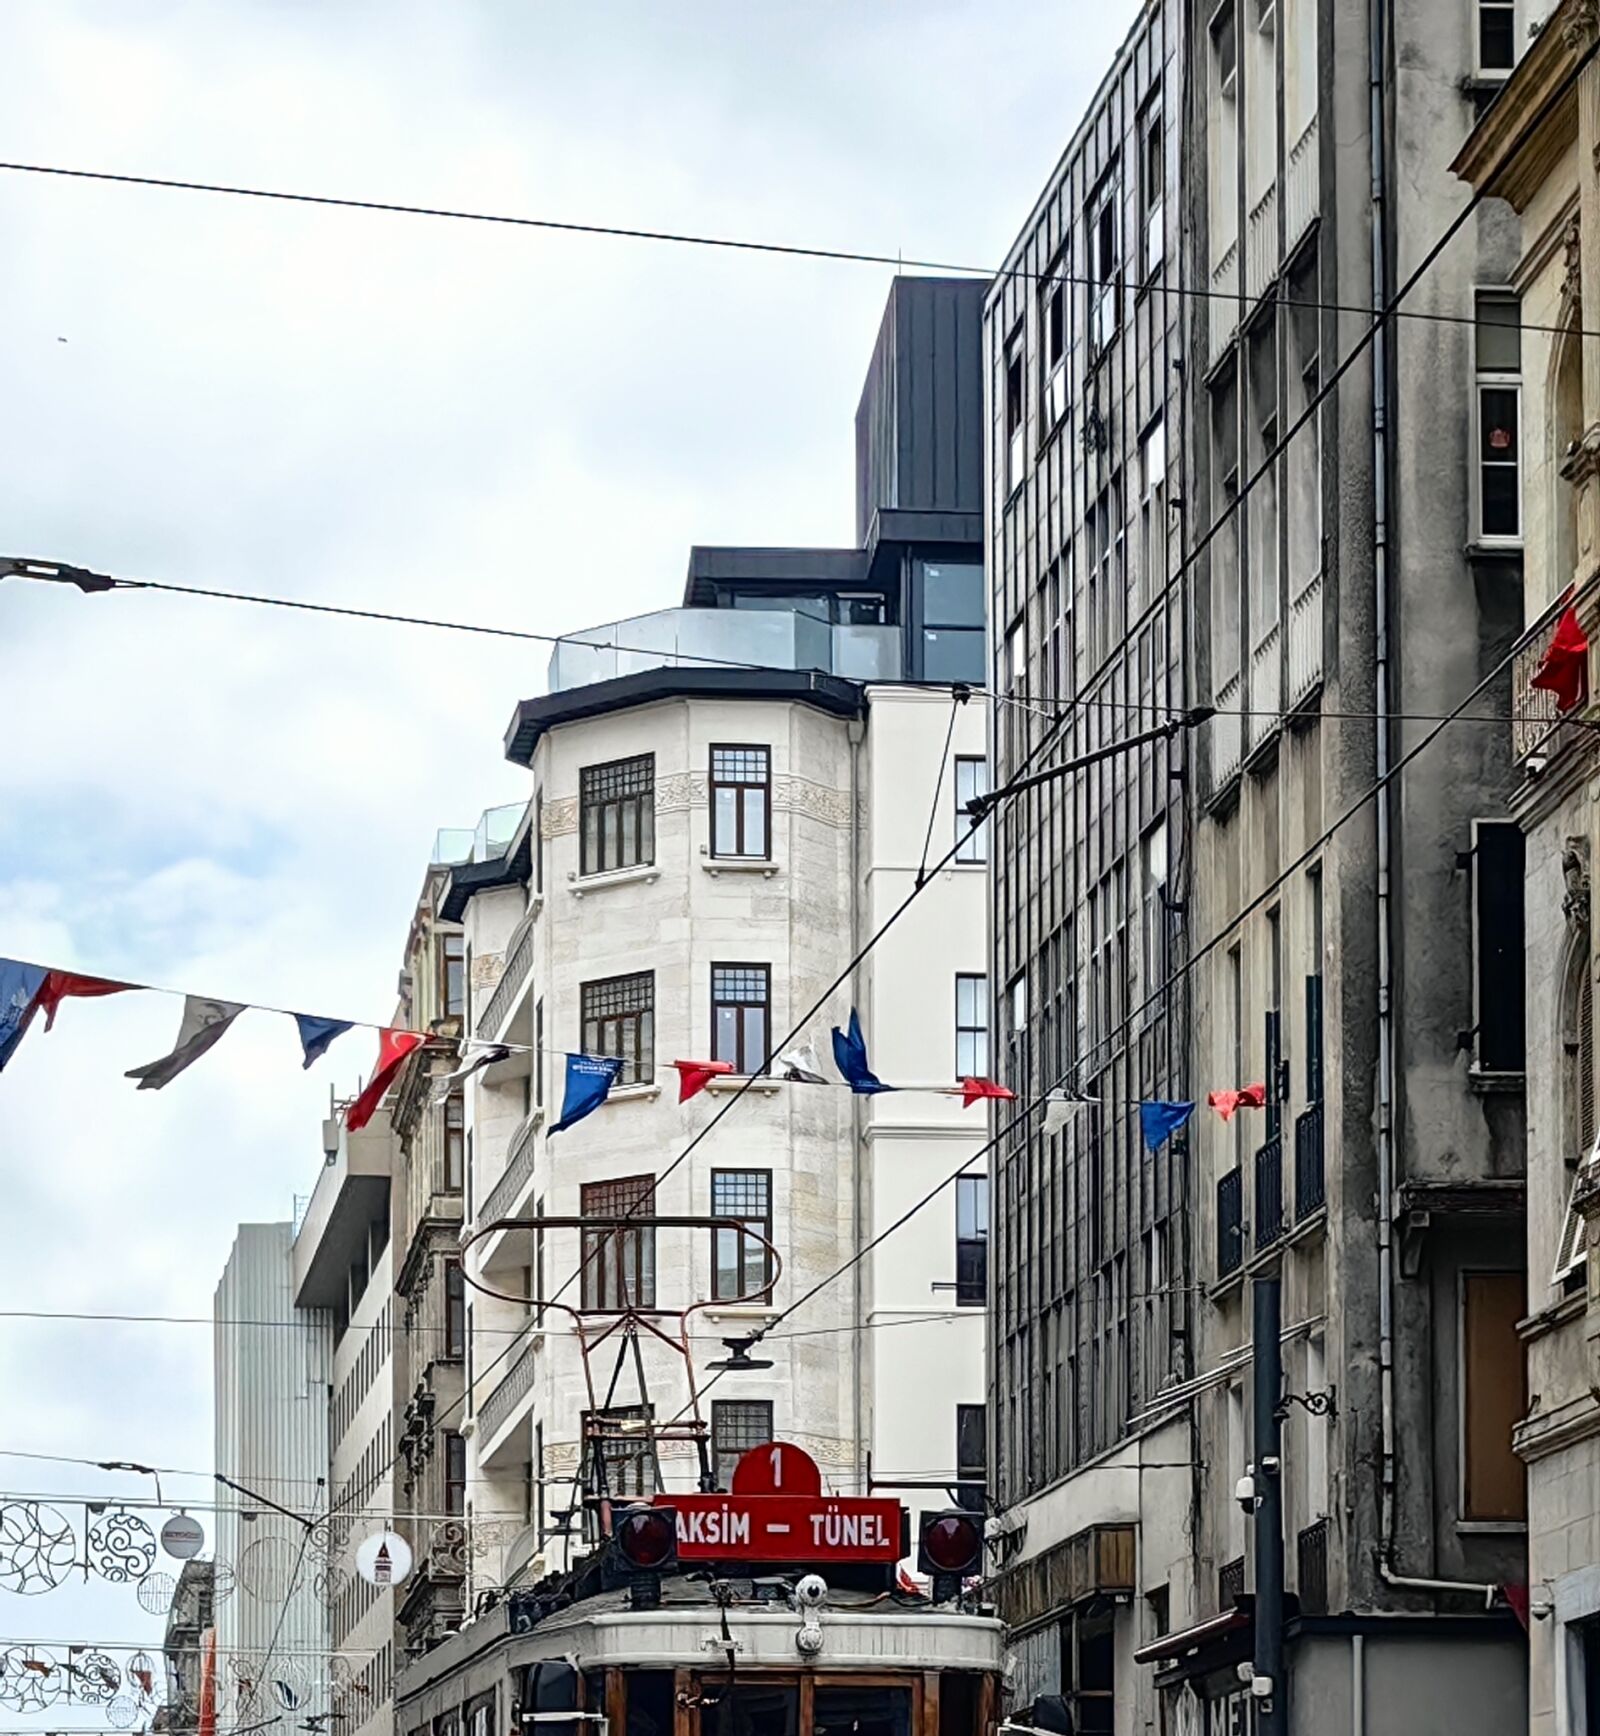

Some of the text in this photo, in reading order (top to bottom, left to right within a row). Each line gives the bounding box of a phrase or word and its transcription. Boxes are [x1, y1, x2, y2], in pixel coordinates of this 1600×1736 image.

[769, 1447, 782, 1488] 1
[675, 1503, 750, 1545] AKSİM
[809, 1505, 890, 1546] TÜNEL
